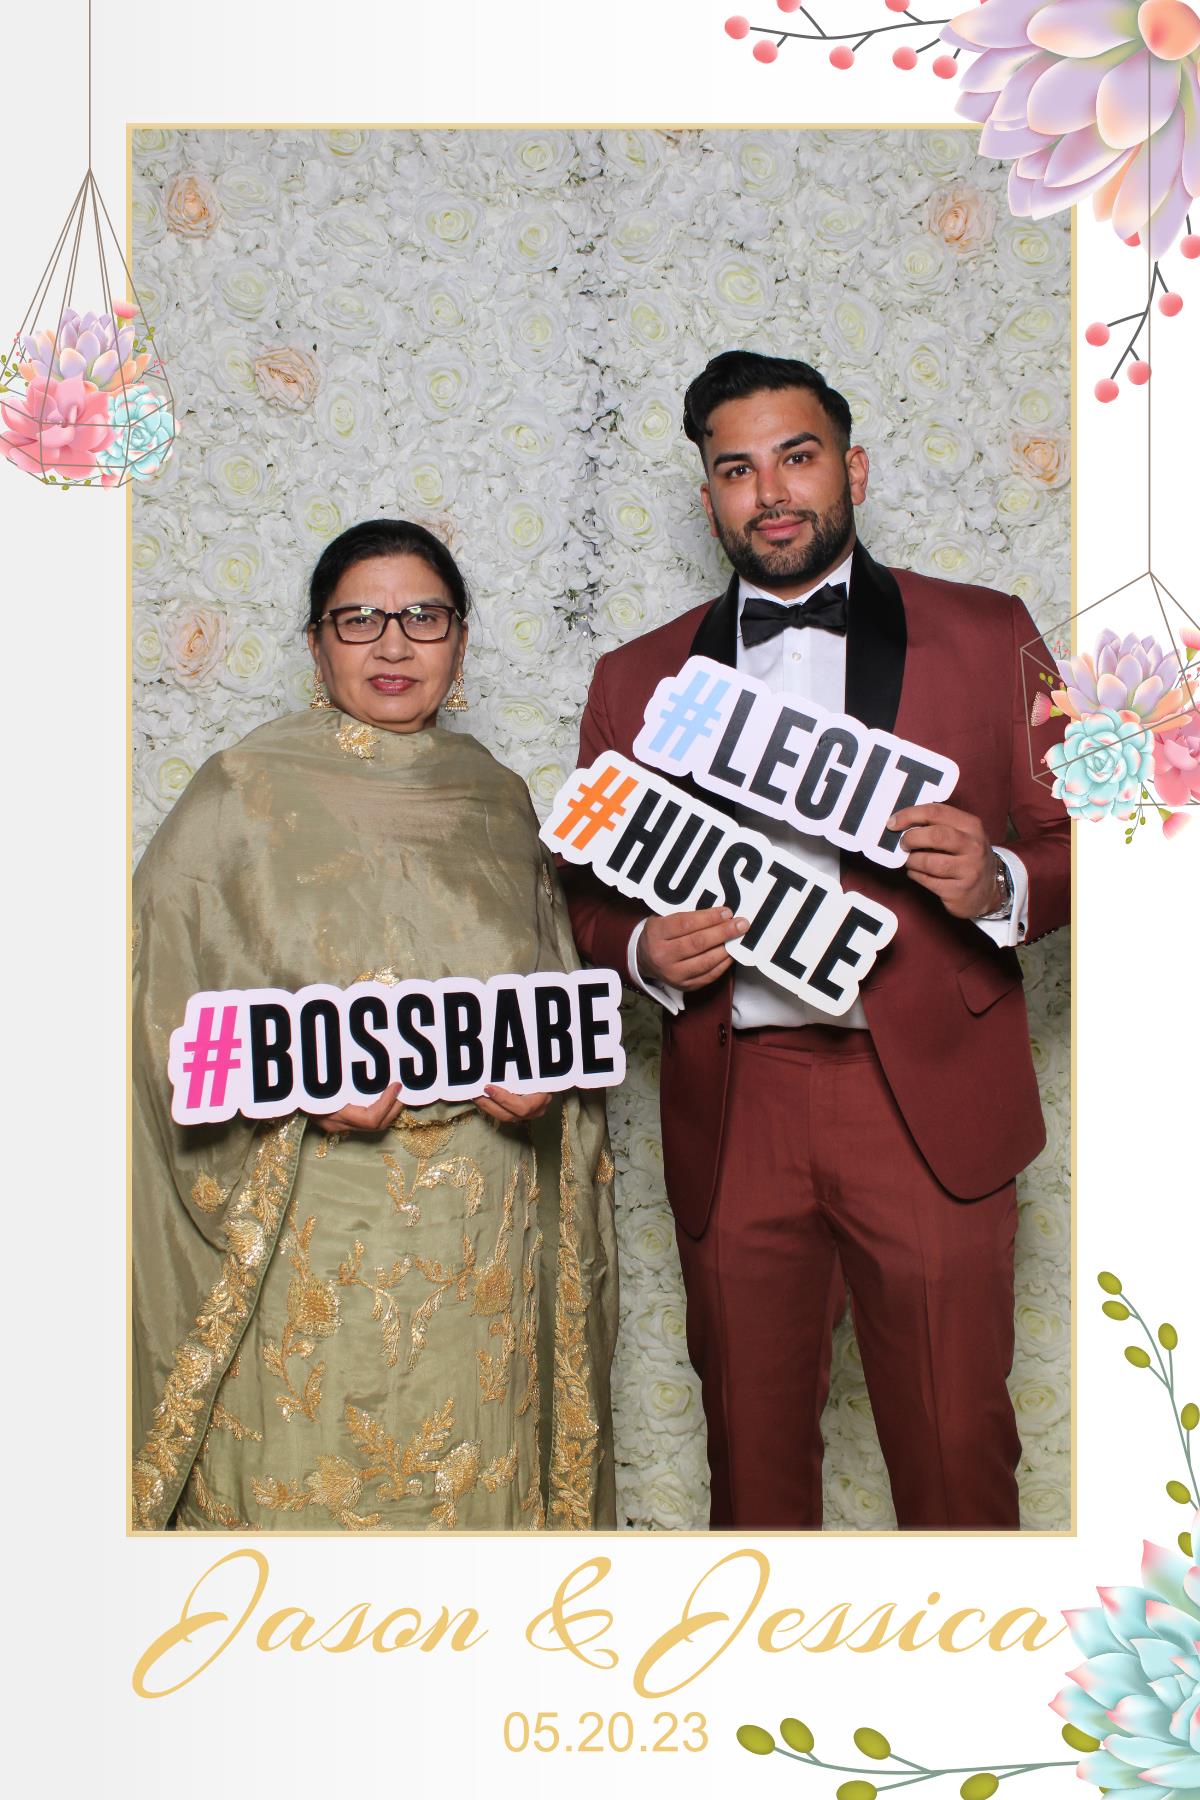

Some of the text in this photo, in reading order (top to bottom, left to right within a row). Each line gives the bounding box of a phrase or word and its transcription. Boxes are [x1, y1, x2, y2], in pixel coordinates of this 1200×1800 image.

[648, 670, 944, 853] #LEGIT
[552, 765, 884, 1001] #HUSTLE
[183, 982, 615, 1109] #BOSSBABE
